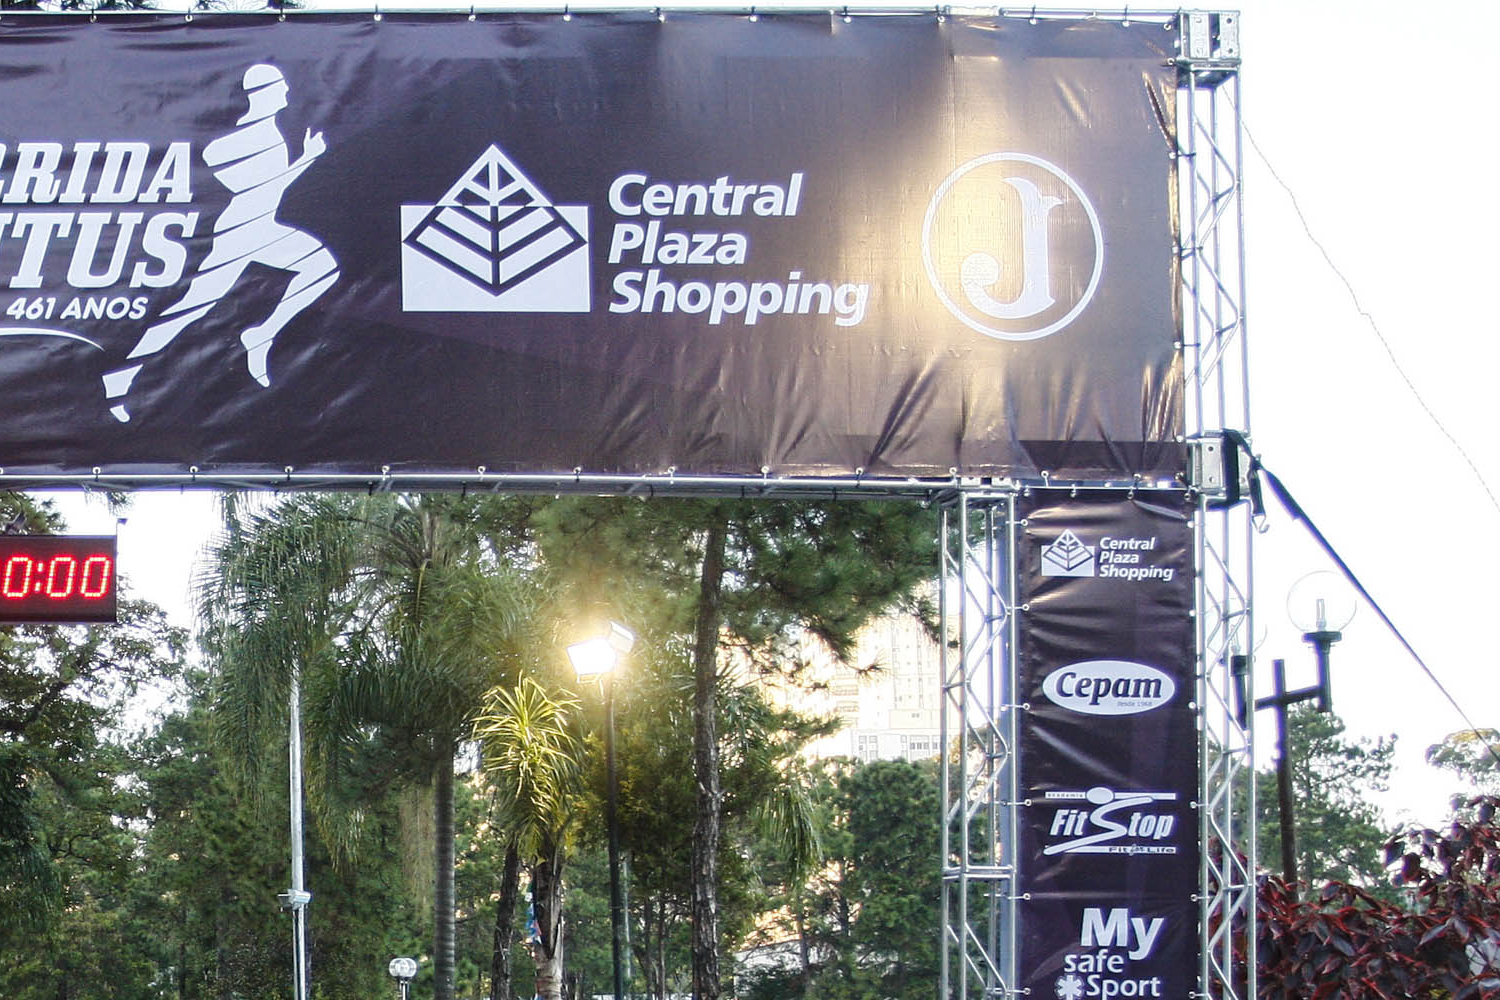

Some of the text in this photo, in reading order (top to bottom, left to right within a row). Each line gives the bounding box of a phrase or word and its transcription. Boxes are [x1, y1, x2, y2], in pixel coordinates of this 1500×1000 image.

[608, 173, 803, 217] Central
[608, 224, 748, 265] Plaza
[6, 297, 56, 320] 461
[63, 296, 148, 320] ANOS
[608, 272, 869, 326] Shopping
[1100, 536, 1156, 550] Central
[1100, 551, 1140, 564] Plaza
[1100, 565, 1174, 581] Shopping
[1056, 672, 1162, 705] Cepam
[1080, 908, 1164, 960] My
[1064, 948, 1124, 974] safe
